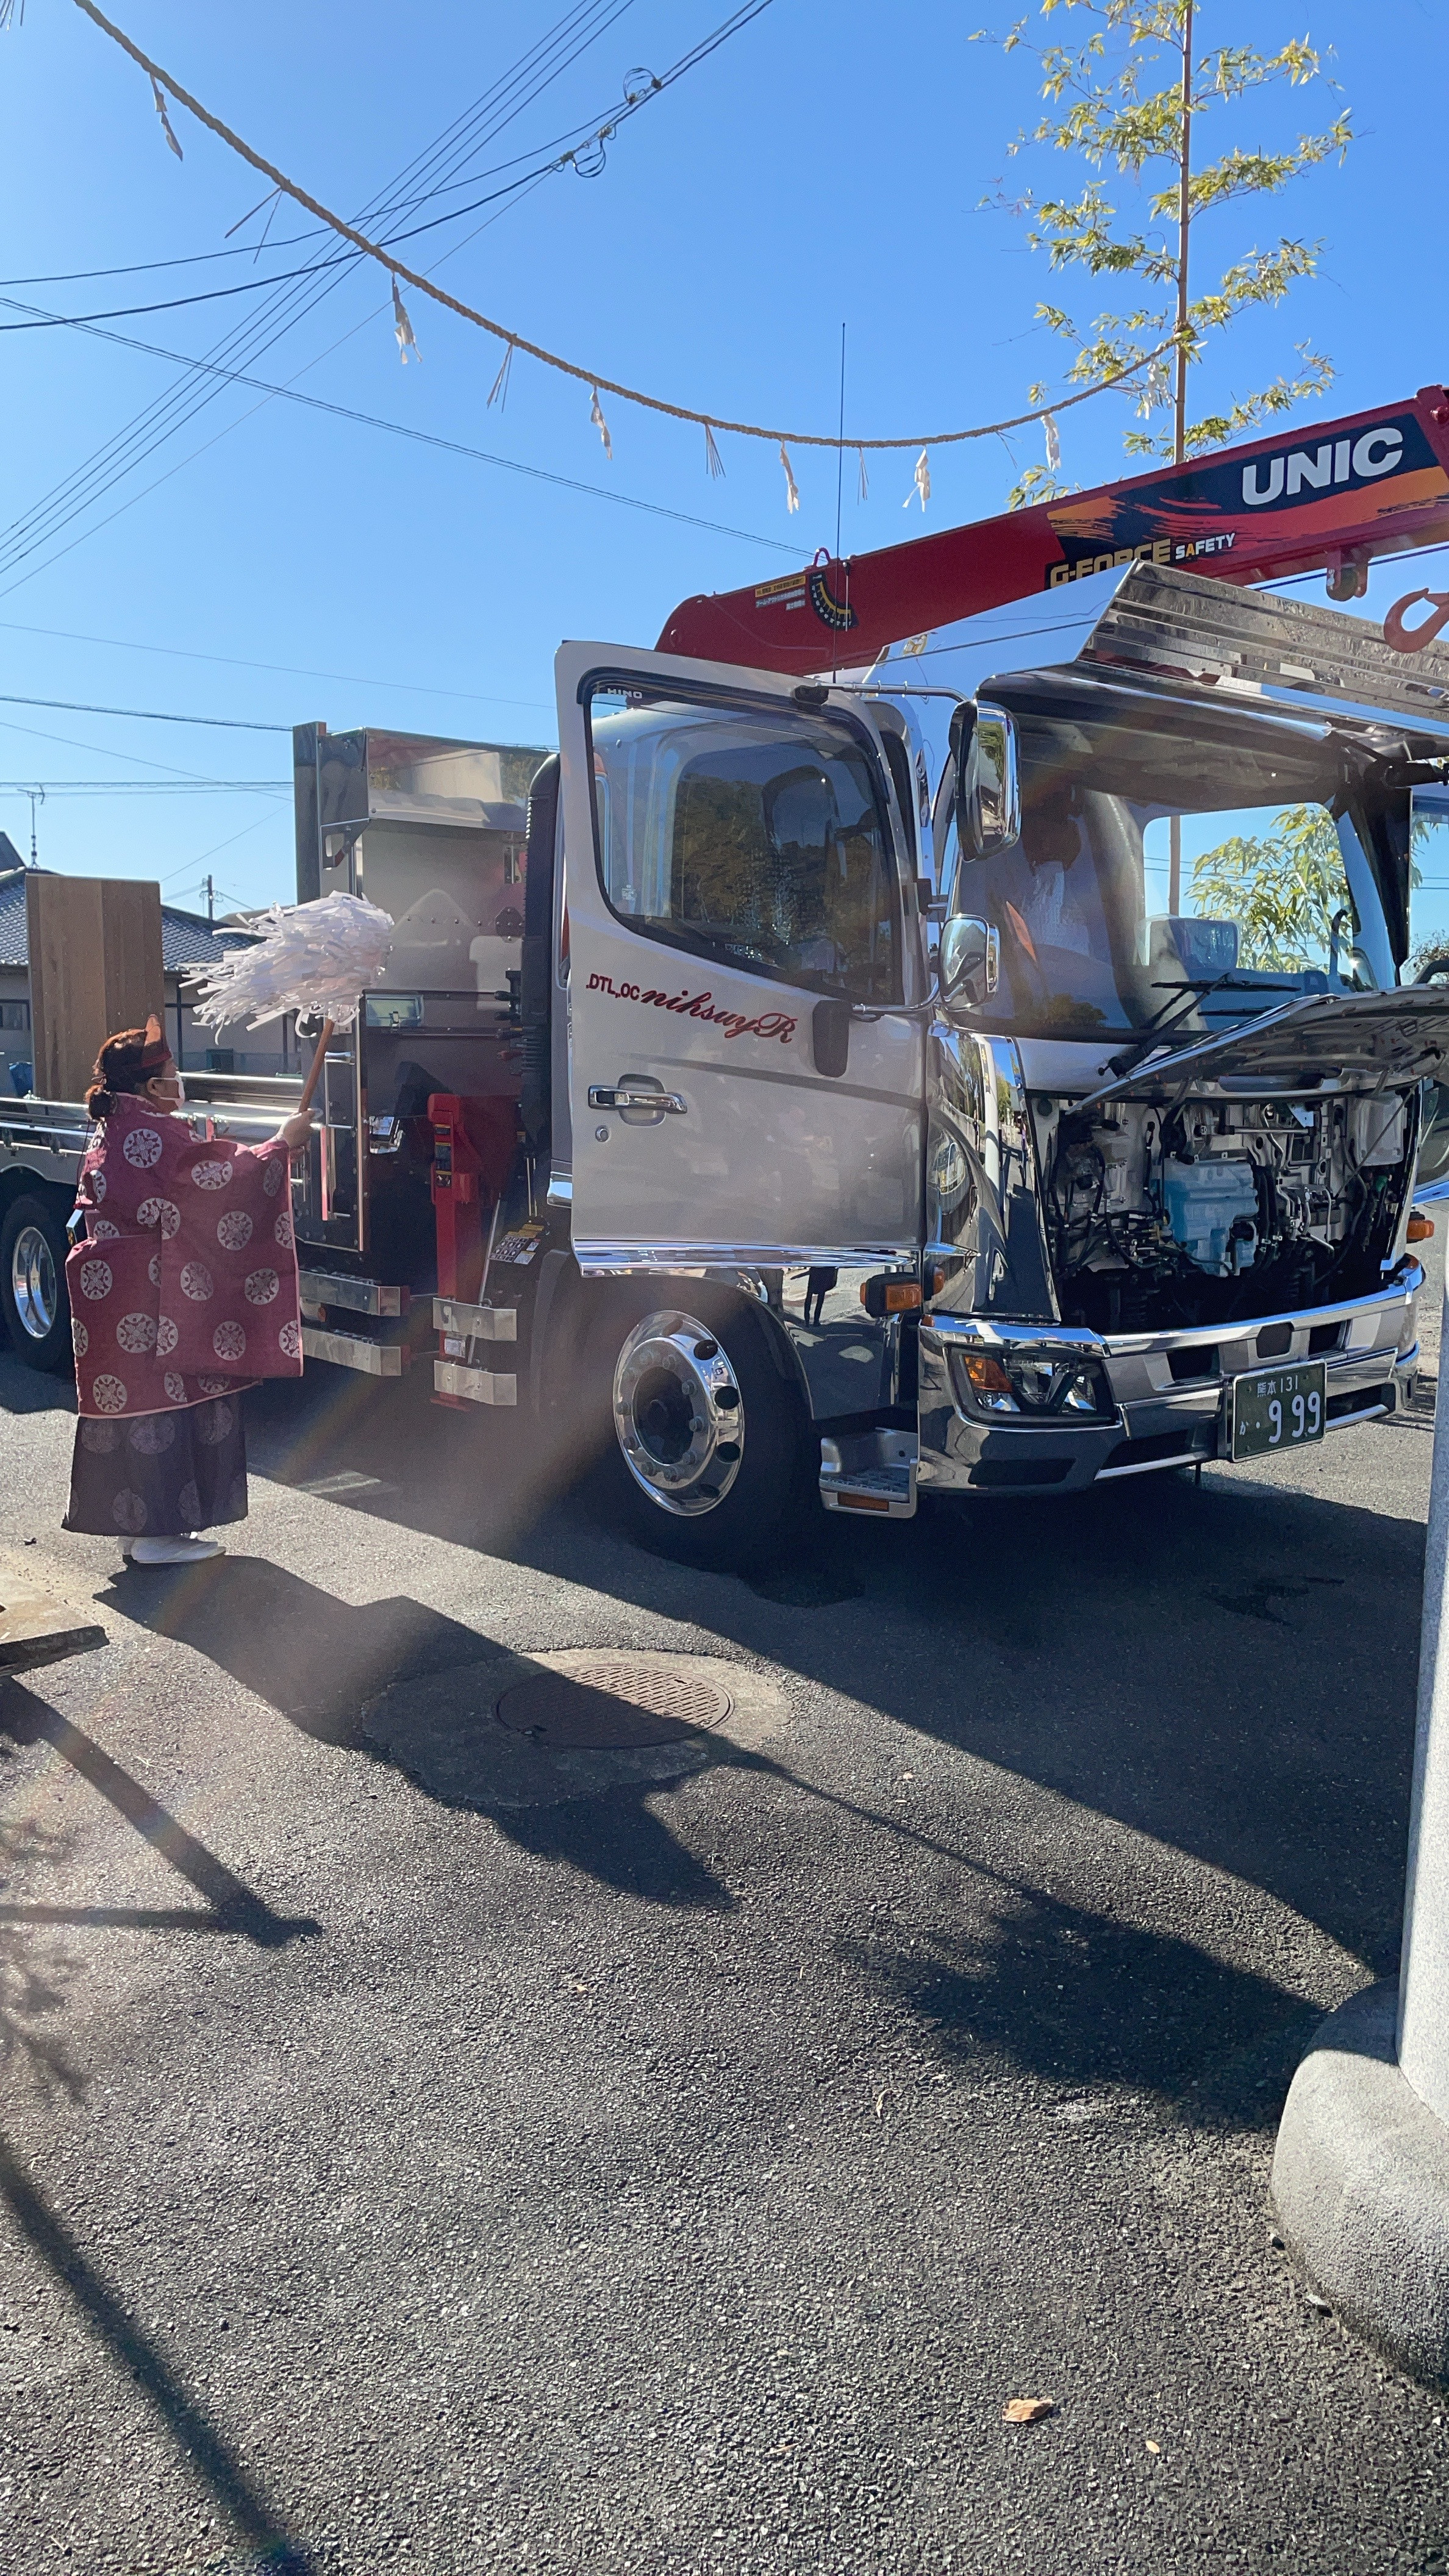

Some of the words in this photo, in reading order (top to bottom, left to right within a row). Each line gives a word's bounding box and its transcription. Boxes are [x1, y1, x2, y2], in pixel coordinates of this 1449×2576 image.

[1242, 428, 1403, 506] UNIC
[1175, 532, 1236, 560] SAFETY
[607, 688, 643, 699] HINO
[1257, 1380, 1276, 1398] 熊本
[1280, 1375, 1298, 1393] 131
